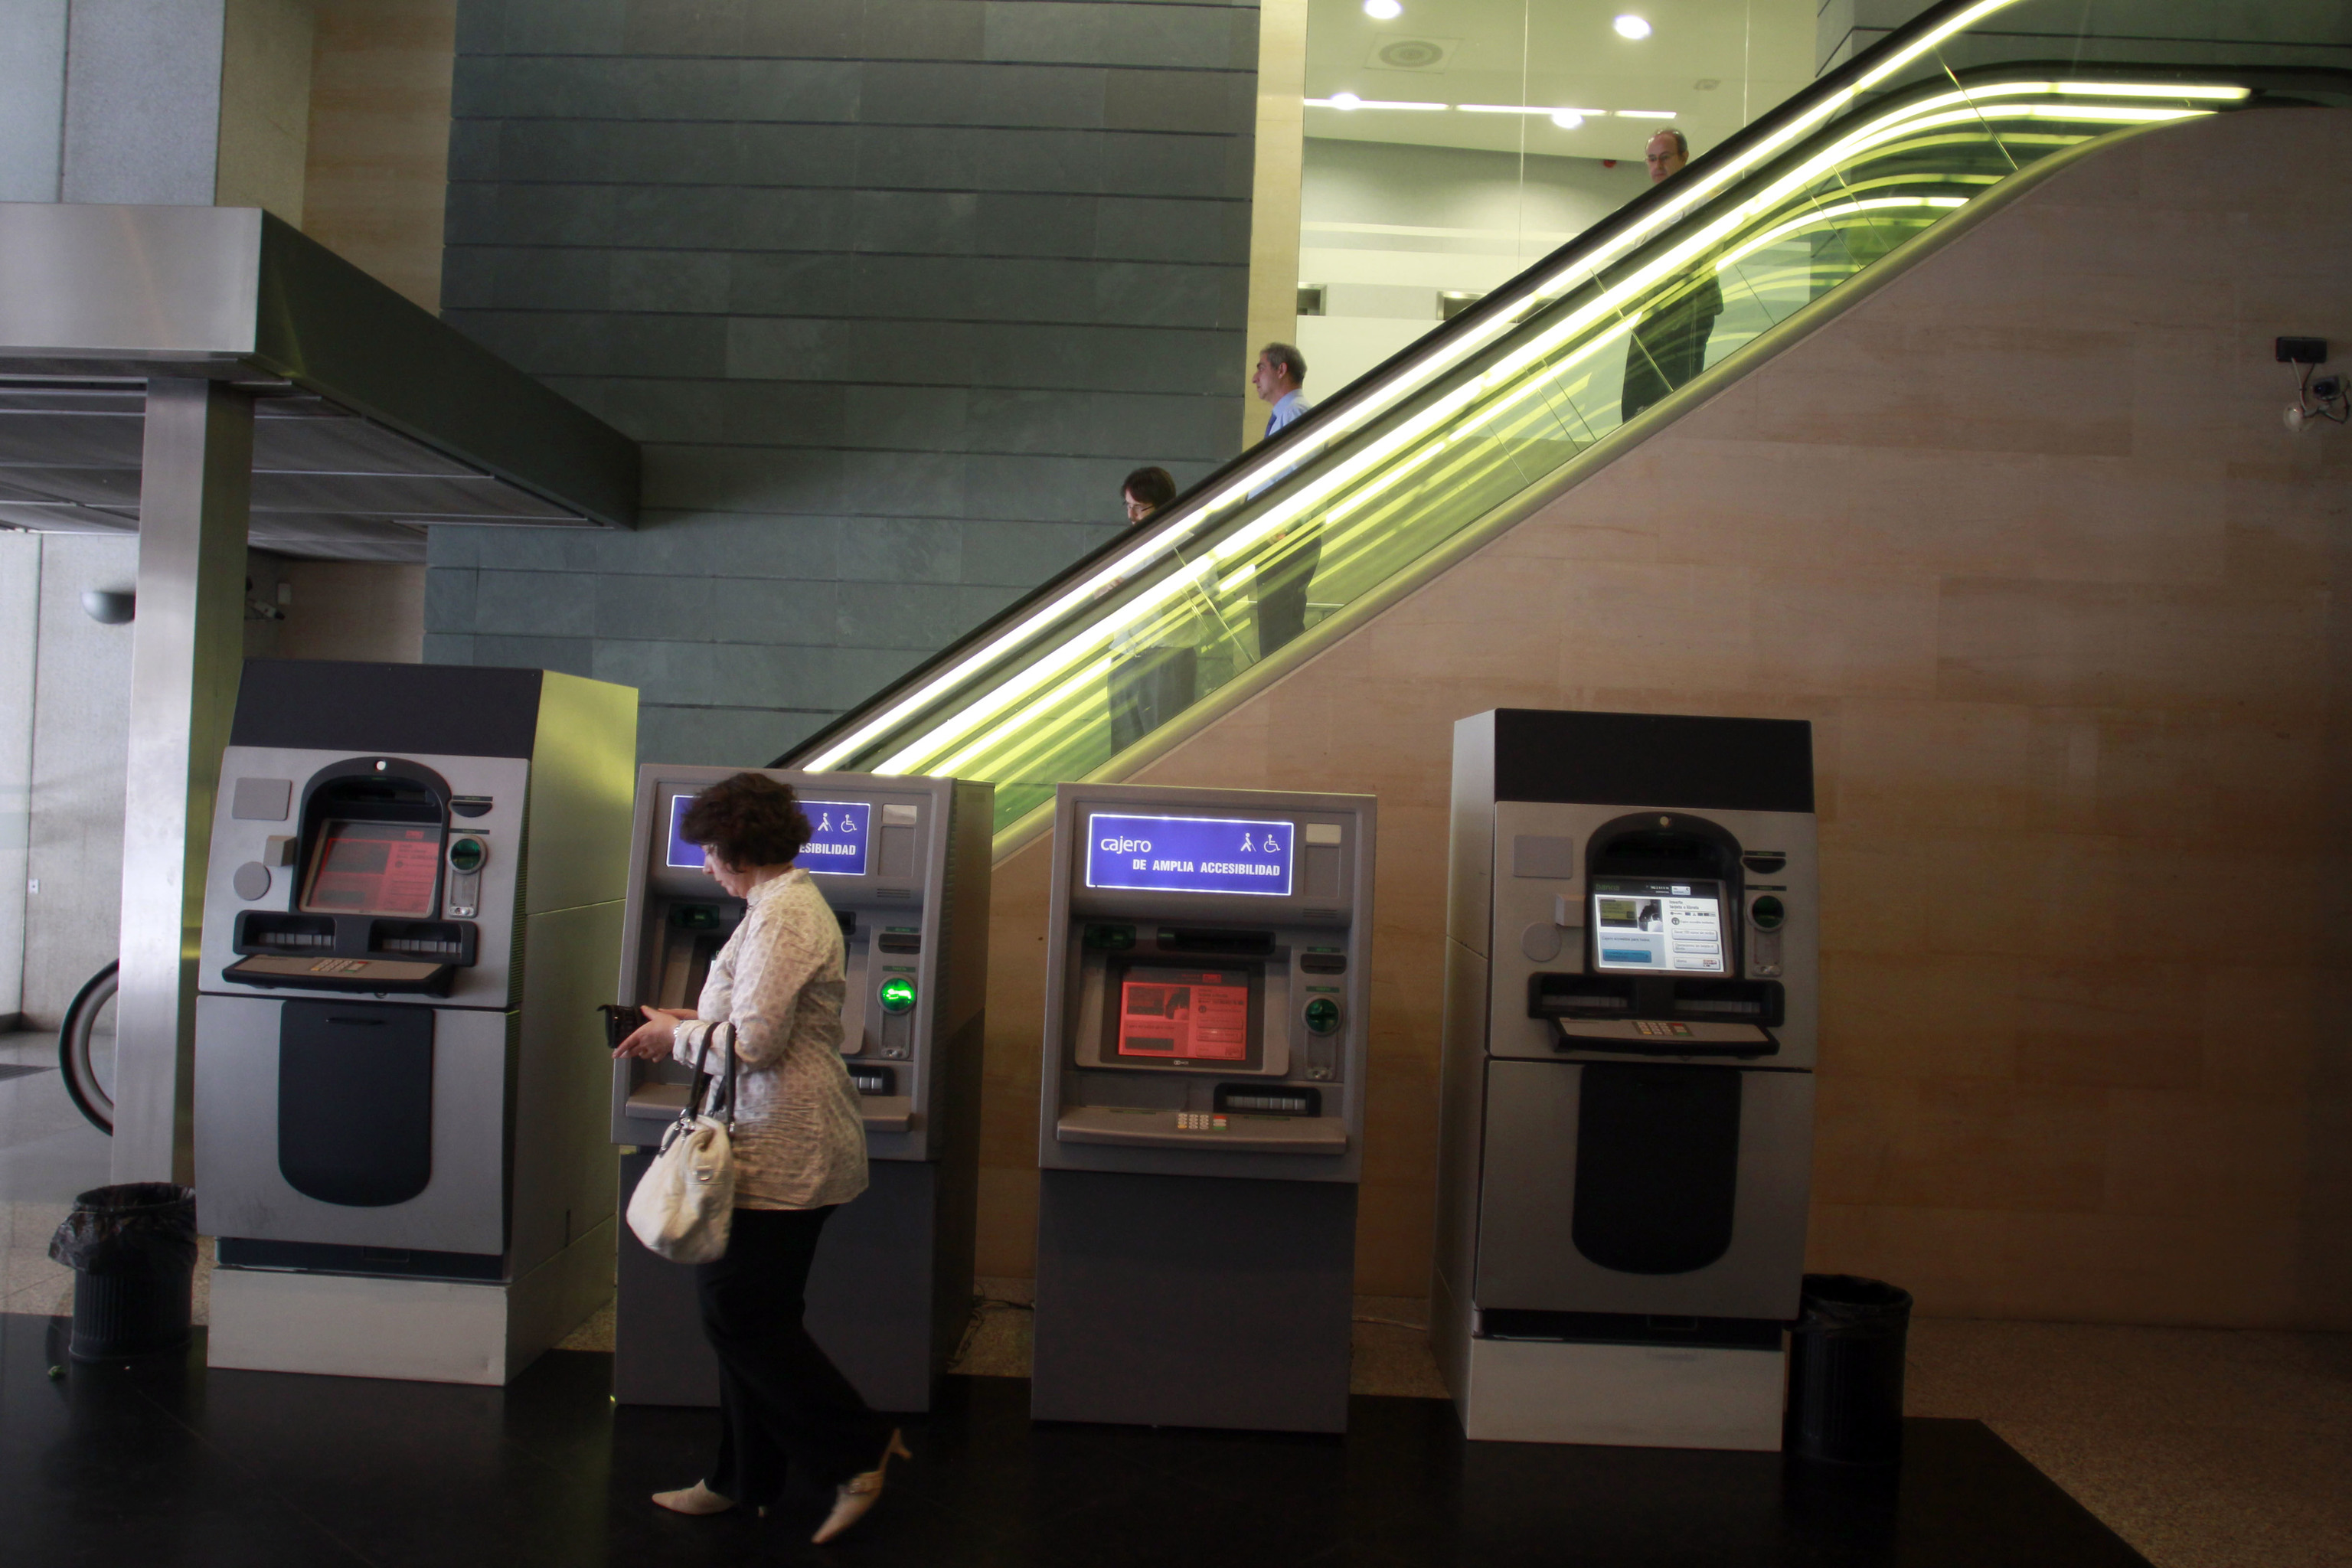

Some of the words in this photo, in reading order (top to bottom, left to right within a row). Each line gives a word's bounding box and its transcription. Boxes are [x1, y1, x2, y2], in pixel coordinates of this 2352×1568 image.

[799, 843, 857, 856] ESIBILIDAD
[1100, 835, 1152, 854] cajero
[1132, 858, 1147, 871] DE
[1152, 860, 1194, 873] AMPLIA
[1200, 861, 1280, 876] ACCESIBILIDAD
